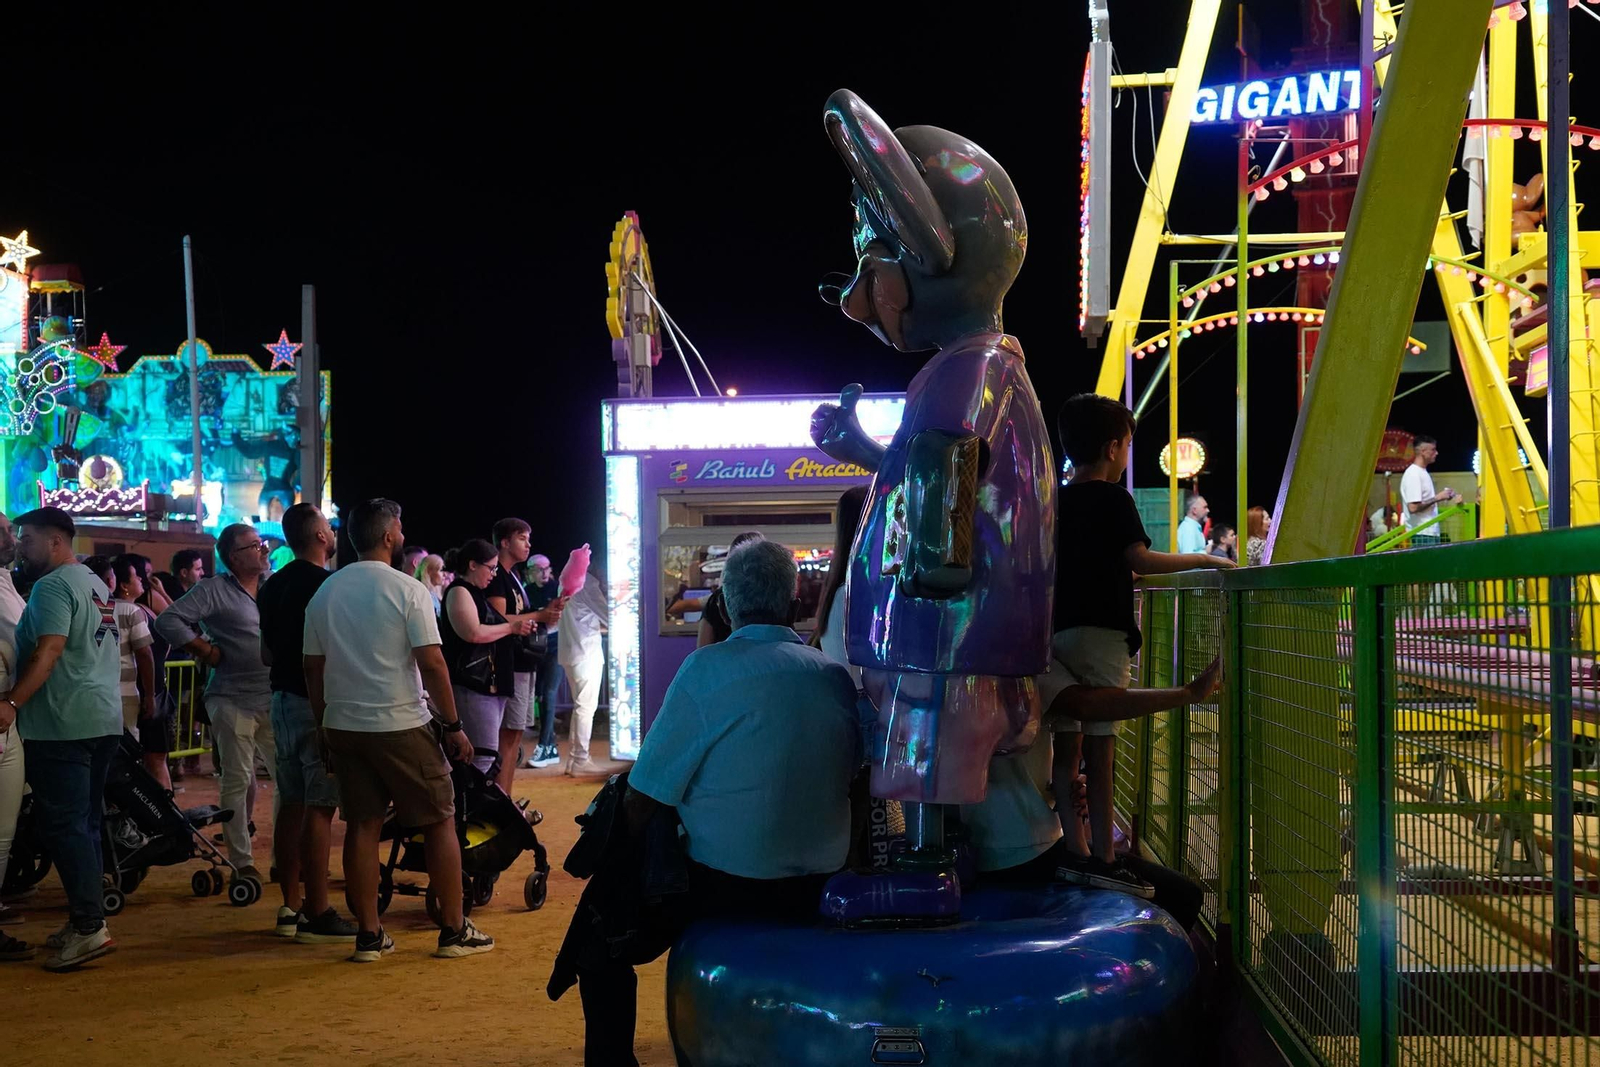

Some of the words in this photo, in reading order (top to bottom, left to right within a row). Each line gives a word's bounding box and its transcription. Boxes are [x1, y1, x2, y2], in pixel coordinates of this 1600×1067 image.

[694, 458, 775, 480] Bañuls
[784, 457, 873, 480] Atraccio
[131, 787, 163, 819] MACLAREN
